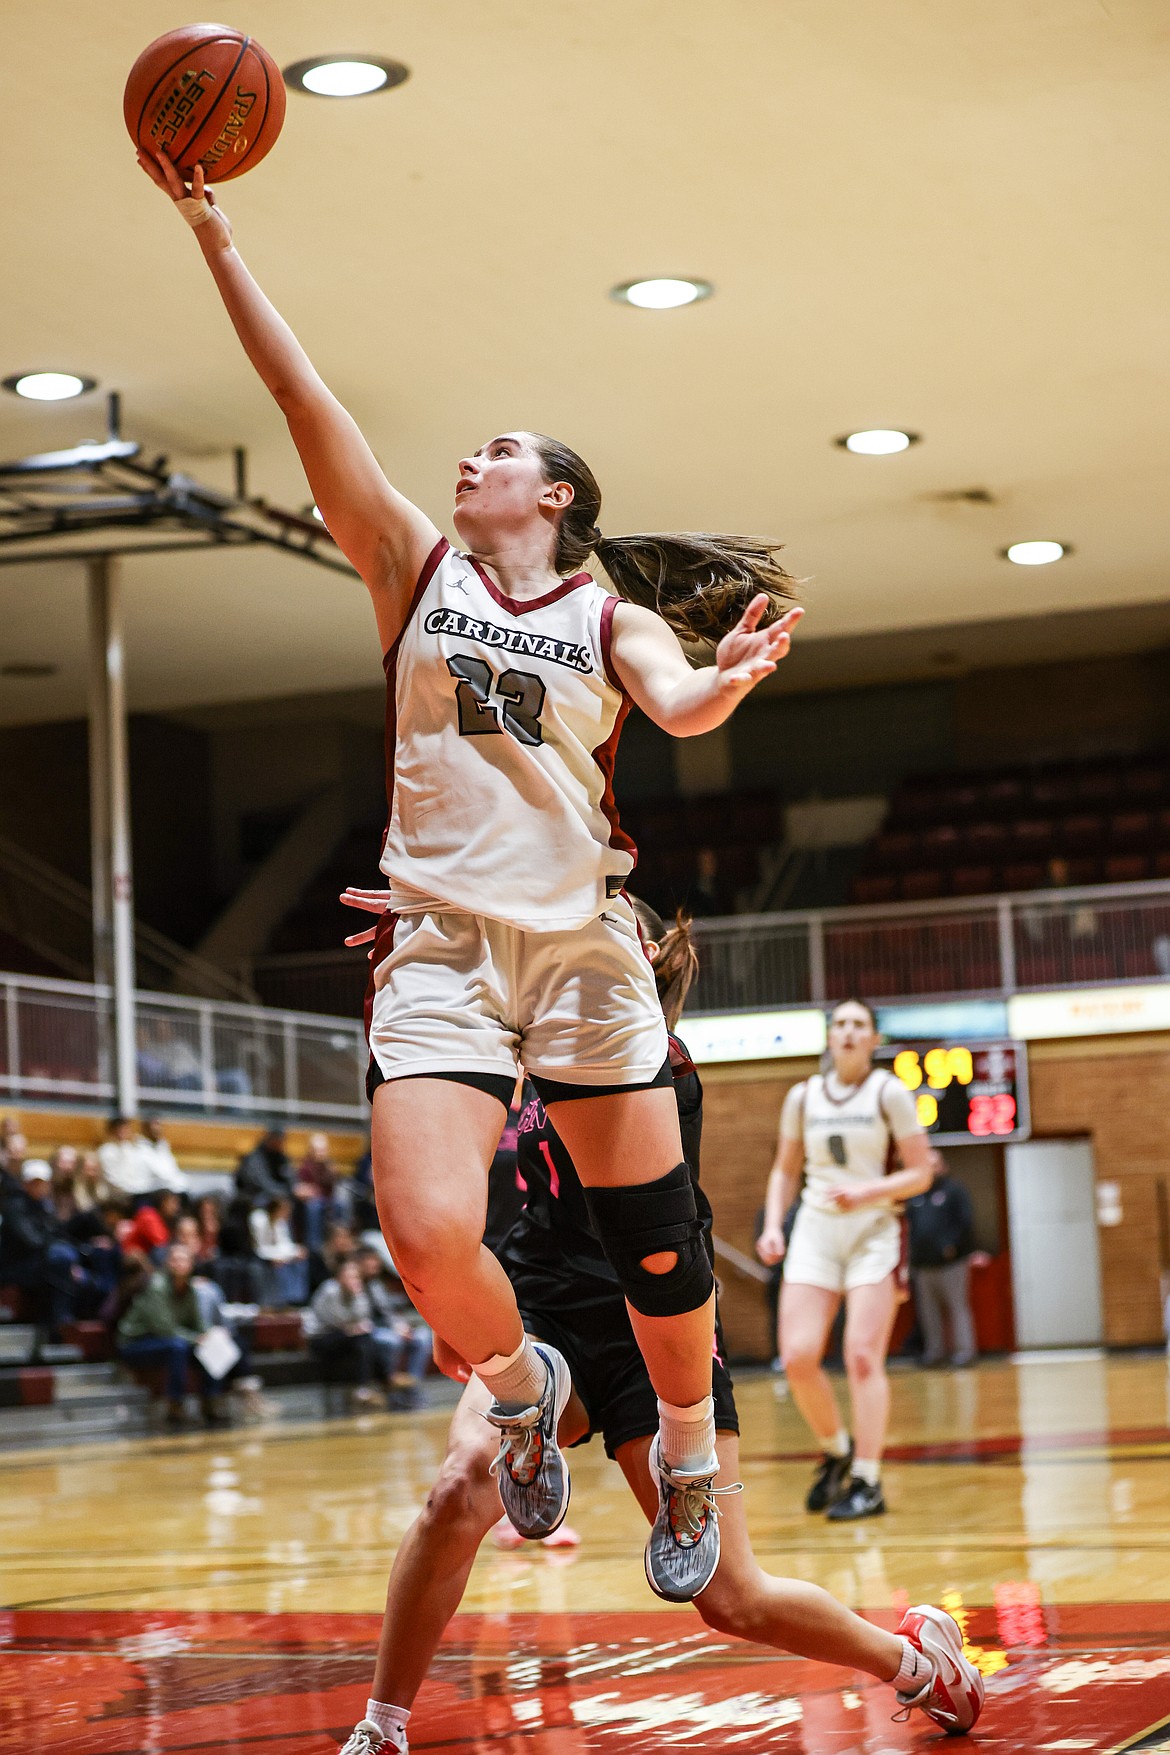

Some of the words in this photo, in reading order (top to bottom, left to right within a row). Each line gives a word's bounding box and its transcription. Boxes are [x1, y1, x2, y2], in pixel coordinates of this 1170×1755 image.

[155, 69, 216, 155] LEGACY
[188, 85, 257, 175] SPALDIN
[424, 608, 593, 674] CARDINALS
